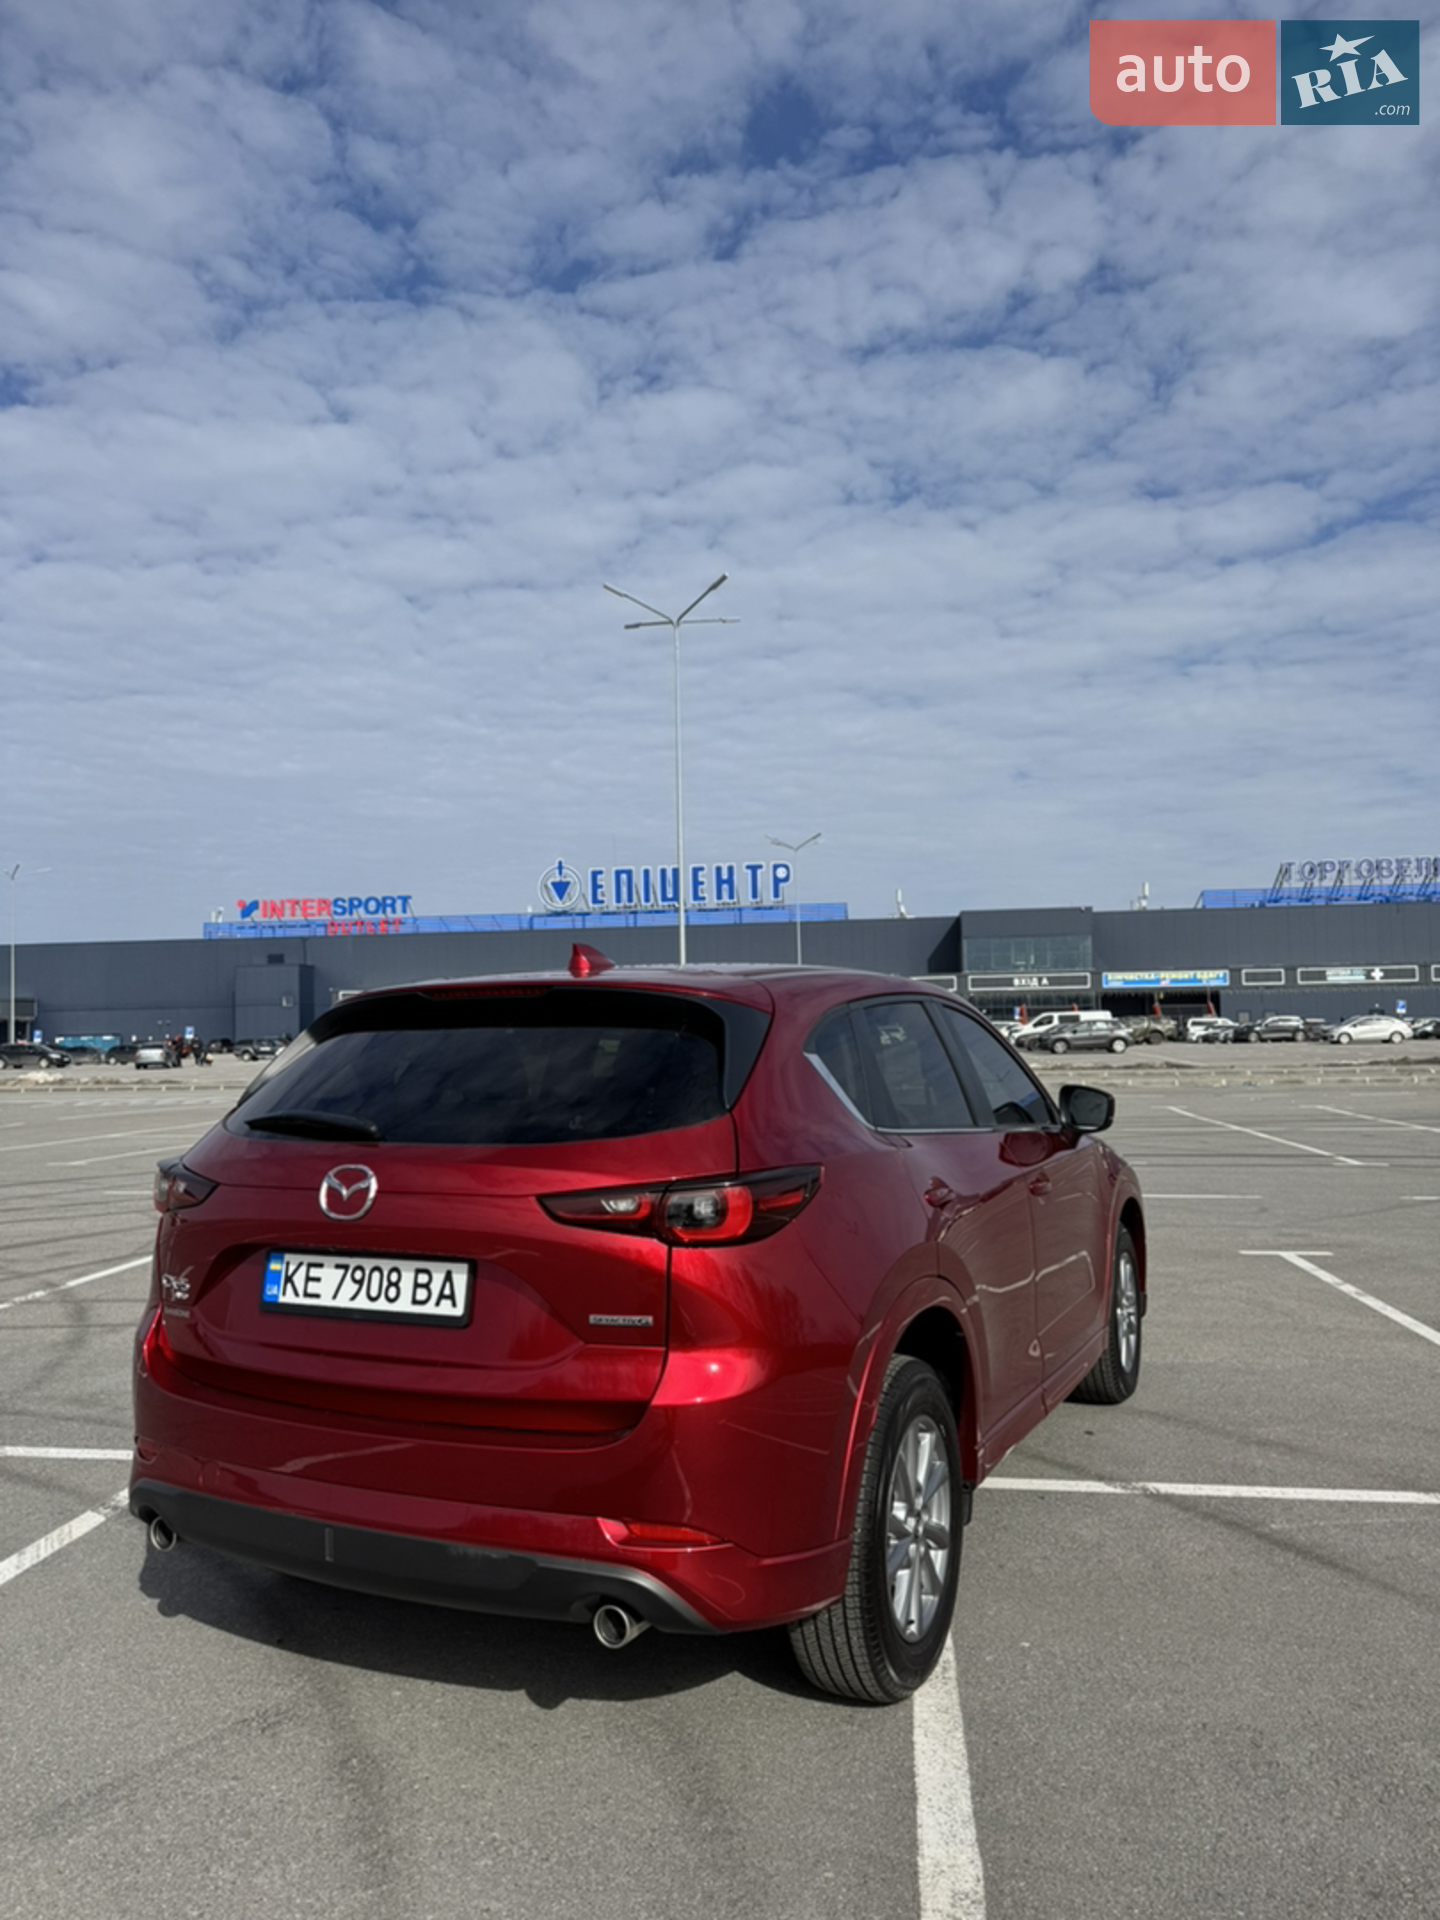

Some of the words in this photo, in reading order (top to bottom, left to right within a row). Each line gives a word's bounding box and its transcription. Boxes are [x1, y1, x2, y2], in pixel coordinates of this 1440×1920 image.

[588, 862, 792, 906] ЕПІЦЕНТР
[259, 895, 412, 919] INTERSPORT
[326, 917, 402, 936] OUTLET
[282, 1260, 324, 1298] KE
[332, 1263, 402, 1304] 7908
[411, 1267, 457, 1308] BA
